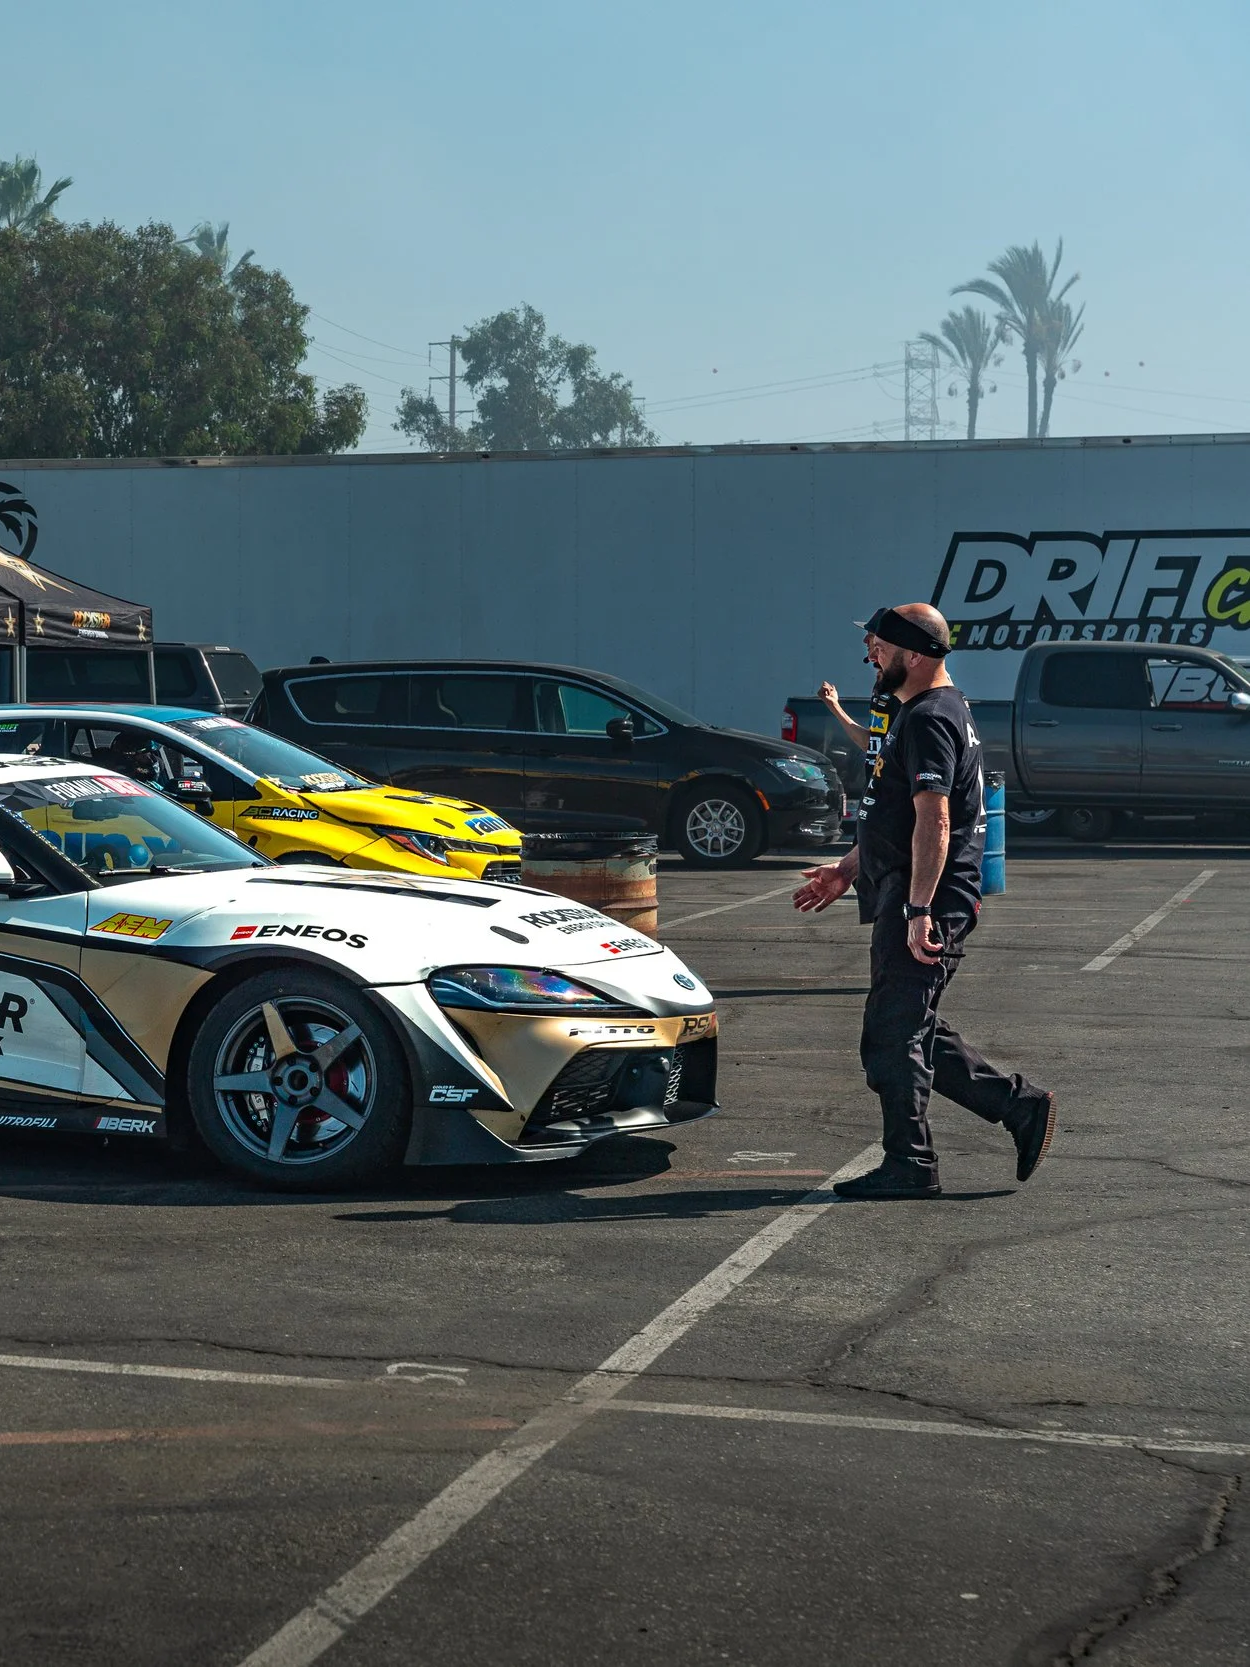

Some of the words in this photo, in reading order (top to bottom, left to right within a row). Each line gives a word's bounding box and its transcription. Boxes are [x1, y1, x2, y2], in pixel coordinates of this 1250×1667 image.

[72, 610, 111, 628] ROCKSTAR
[967, 623, 1207, 646] MOTORSPORTS
[44, 778, 115, 801] FORMULA
[272, 808, 318, 819] RACING
[89, 912, 174, 940] AEM
[255, 924, 369, 949] ENEOS
[429, 1088, 479, 1102] CSF
[105, 1116, 157, 1133] BERK
